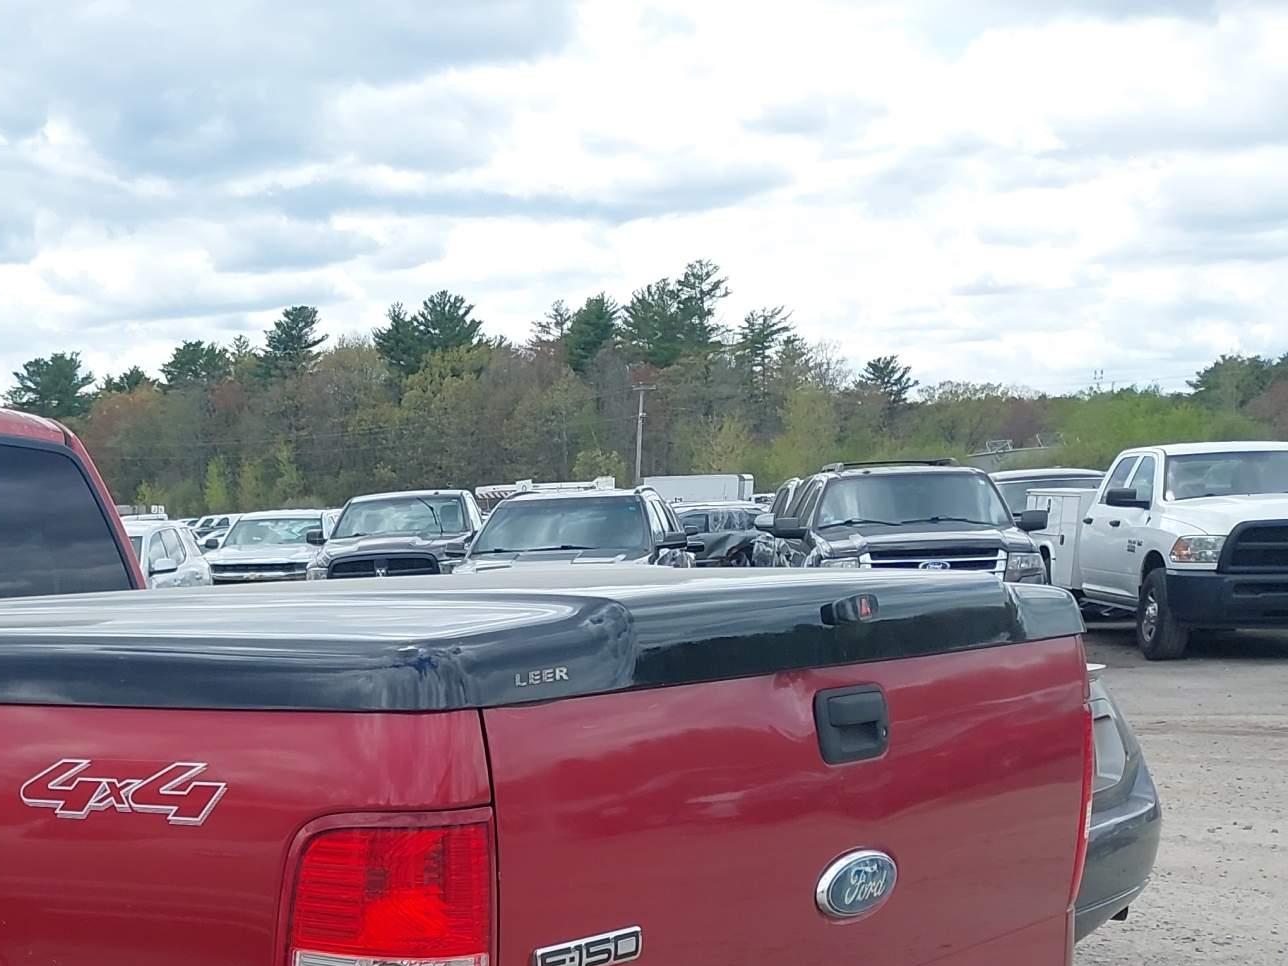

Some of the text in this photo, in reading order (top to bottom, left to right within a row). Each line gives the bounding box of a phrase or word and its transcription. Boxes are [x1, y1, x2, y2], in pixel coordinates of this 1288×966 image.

[515, 666, 569, 688] LEER
[20, 758, 228, 826] 4x4
[844, 863, 888, 905] Ford
